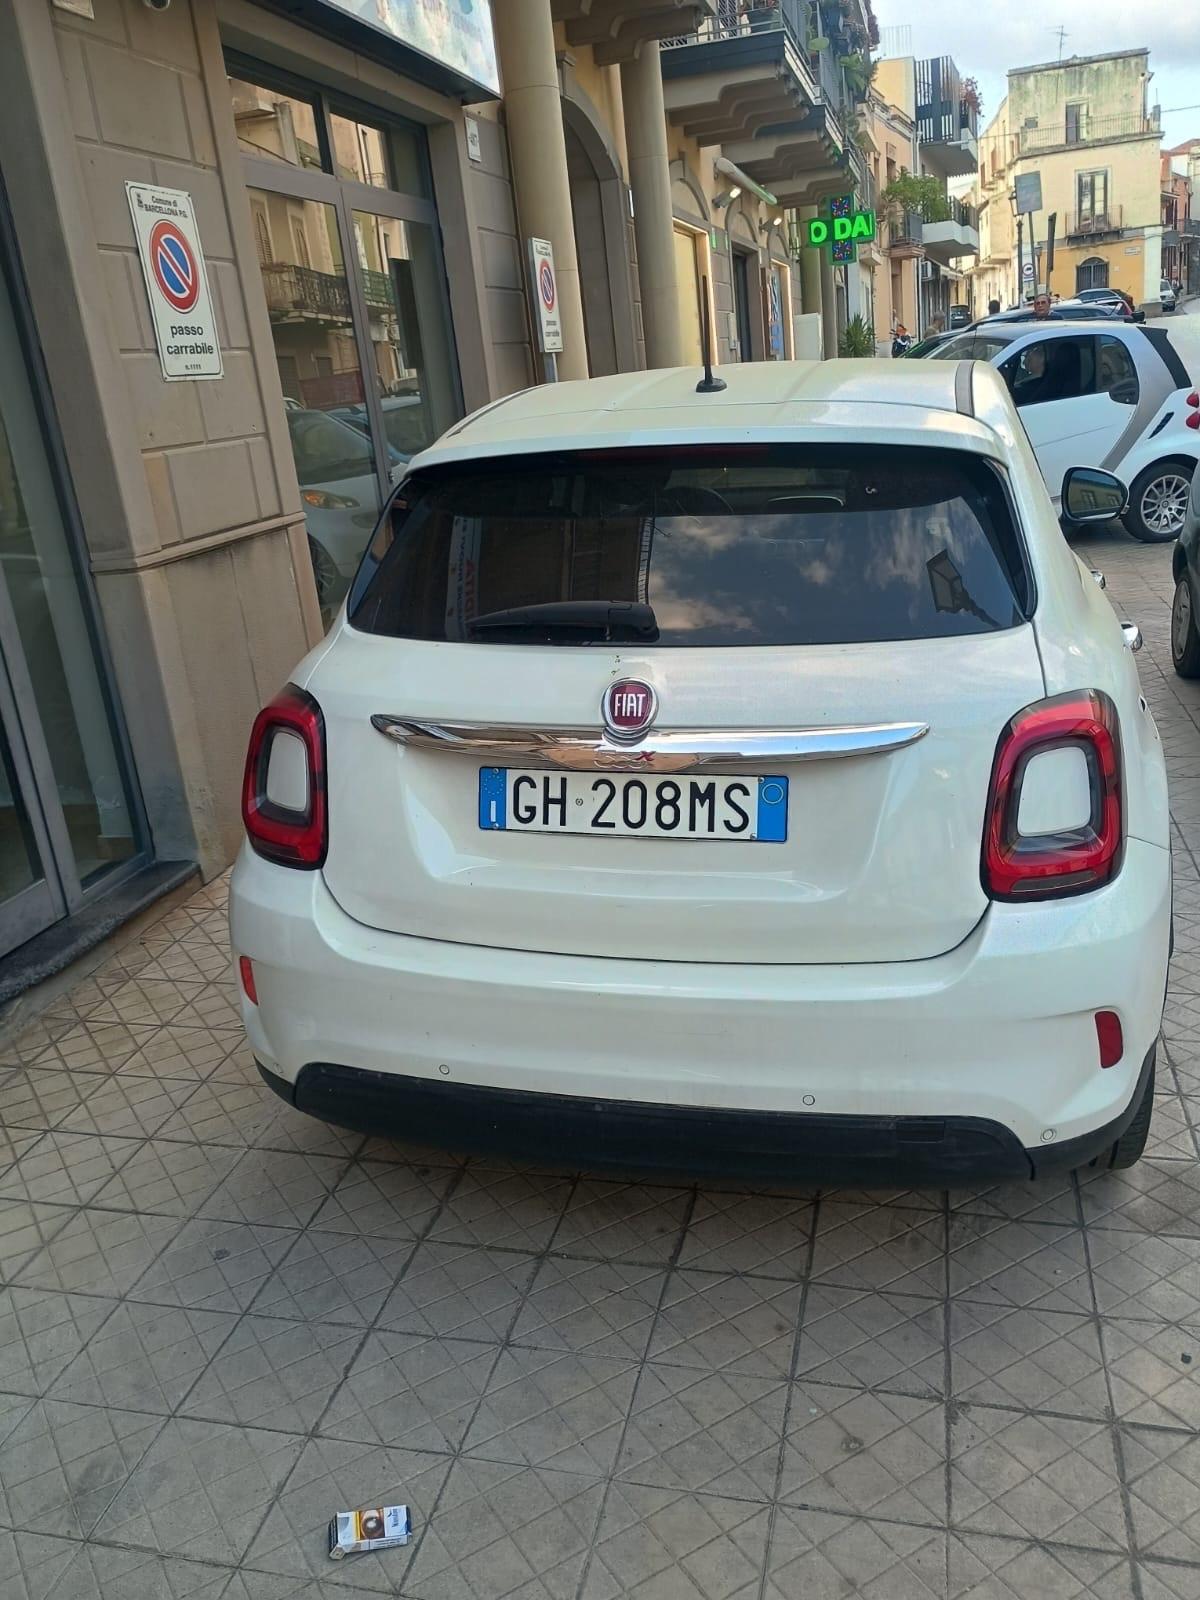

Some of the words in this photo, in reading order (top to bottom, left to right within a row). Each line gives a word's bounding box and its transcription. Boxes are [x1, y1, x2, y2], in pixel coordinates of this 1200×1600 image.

[170, 325, 204, 338] passo
[166, 342, 214, 355] carrabile
[614, 693, 646, 717] FIAT
[512, 775, 568, 827] GH
[590, 777, 751, 834] 208MS
